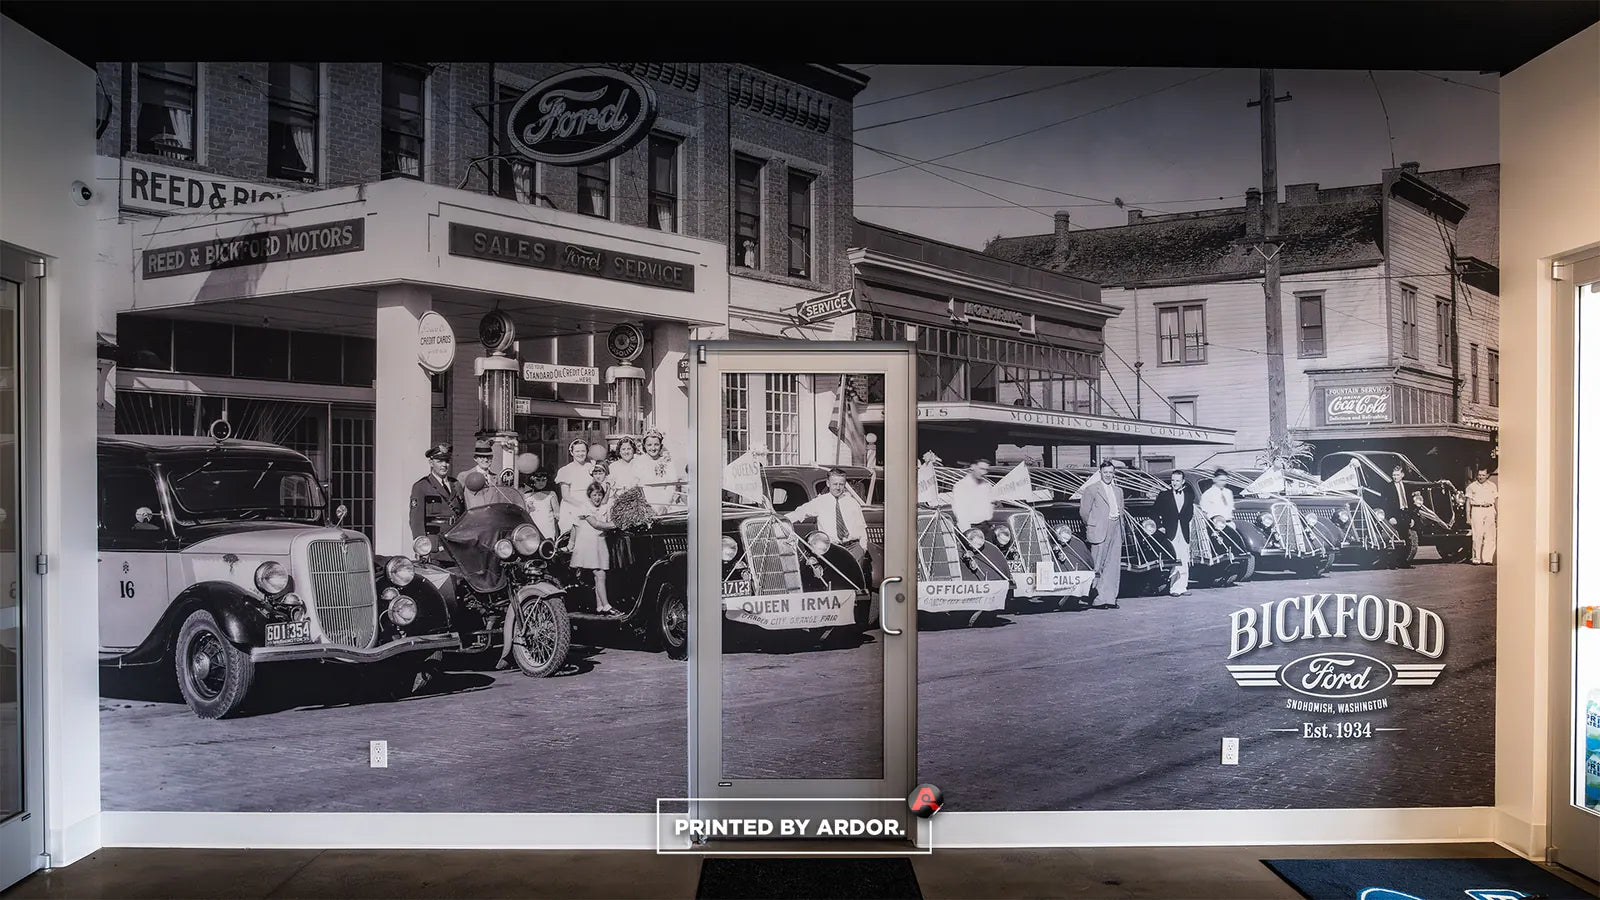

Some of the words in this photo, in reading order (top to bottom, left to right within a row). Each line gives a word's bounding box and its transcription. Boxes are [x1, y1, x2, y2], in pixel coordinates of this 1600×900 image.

[523, 85, 630, 145] Ford
[131, 167, 205, 209] REED
[209, 182, 227, 210] &
[148, 250, 185, 273] REED
[190, 250, 201, 268] &
[205, 234, 280, 265] BICKFORD
[286, 224, 353, 252] MOTORS
[472, 231, 546, 263] SALES
[563, 243, 601, 272] Ford
[613, 256, 684, 286] SERVICE
[805, 295, 850, 318] SERVICE
[525, 369, 554, 380] STANDARD
[554, 368, 564, 379] OIL
[563, 367, 580, 378] CREDIT
[580, 367, 596, 377] CARD
[1010, 410, 1093, 428] MOEHRING
[1102, 421, 1142, 434] SHOE
[1150, 426, 1210, 441] COMPANY
[120, 580, 136, 600] 16
[926, 584, 991, 596] OFFICIALS
[742, 598, 790, 615] QUEEN
[801, 595, 842, 611] IRMA
[819, 614, 839, 623] FAIR
[1226, 592, 1446, 660] BICKFORD
[1301, 657, 1372, 690] Ford
[1286, 697, 1337, 715] SNOHOMISH,
[1338, 697, 1389, 714] WASHINGTON
[1302, 722, 1333, 739] Est.
[1336, 722, 1372, 739] 1934
